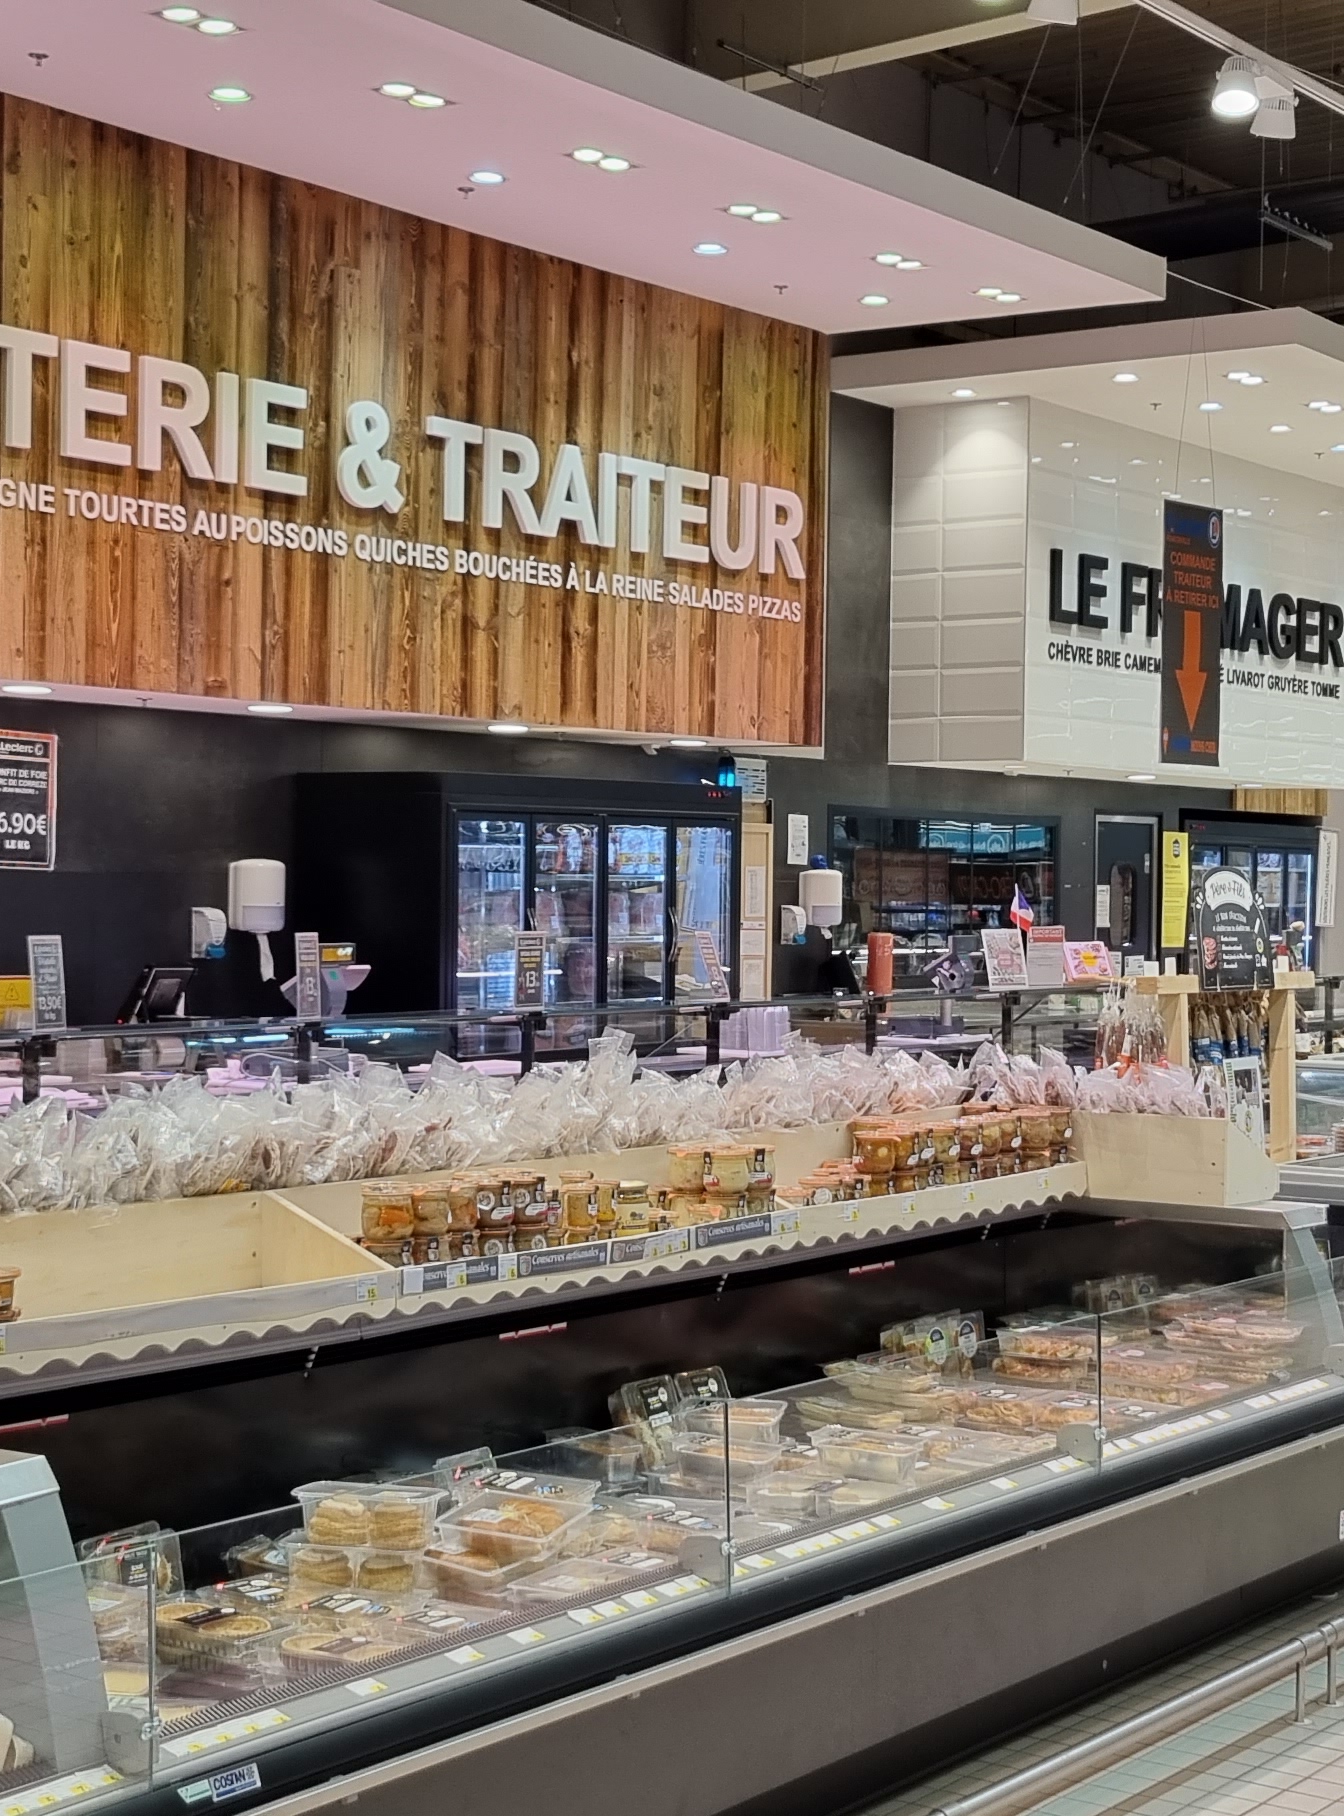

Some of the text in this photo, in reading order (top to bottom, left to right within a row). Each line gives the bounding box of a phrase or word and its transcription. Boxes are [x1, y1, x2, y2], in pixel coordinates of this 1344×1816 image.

[337, 400, 404, 514] &
[425, 415, 806, 580] TRAITEUR
[64, 487, 186, 533] TOURTES
[230, 515, 348, 558] POISSONS
[355, 533, 449, 572] QUICHES
[455, 550, 562, 589] BOUCHÉES
[566, 561, 579, 591] À
[585, 568, 609, 595] LA
[612, 574, 665, 606] REINE
[669, 581, 744, 615] SALADES
[749, 595, 801, 623] PIZZAS
[1170, 551, 1216, 571] COMMANDE
[1174, 570, 1212, 589] TRAITEUR
[1049, 548, 1344, 668] LE FRMAGER
[1174, 589, 1207, 607] RETIRER
[1208, 595, 1219, 609] ICI
[1048, 641, 1093, 665] CHÈVRE
[1097, 649, 1121, 669] BRIE
[1226, 667, 1265, 690] LIVAROT
[1268, 673, 1309, 695] GRUYÈRE
[1311, 681, 1341, 699] TOMME
[18, 769, 29, 778] DE
[30, 770, 48, 779] FOIE
[5, 839, 30, 850] LE KG
[708, 1219, 764, 1237] Conserves artisanales
[532, 1247, 599, 1266] Conserves artisanales
[213, 1769, 246, 1790] COSTAN
